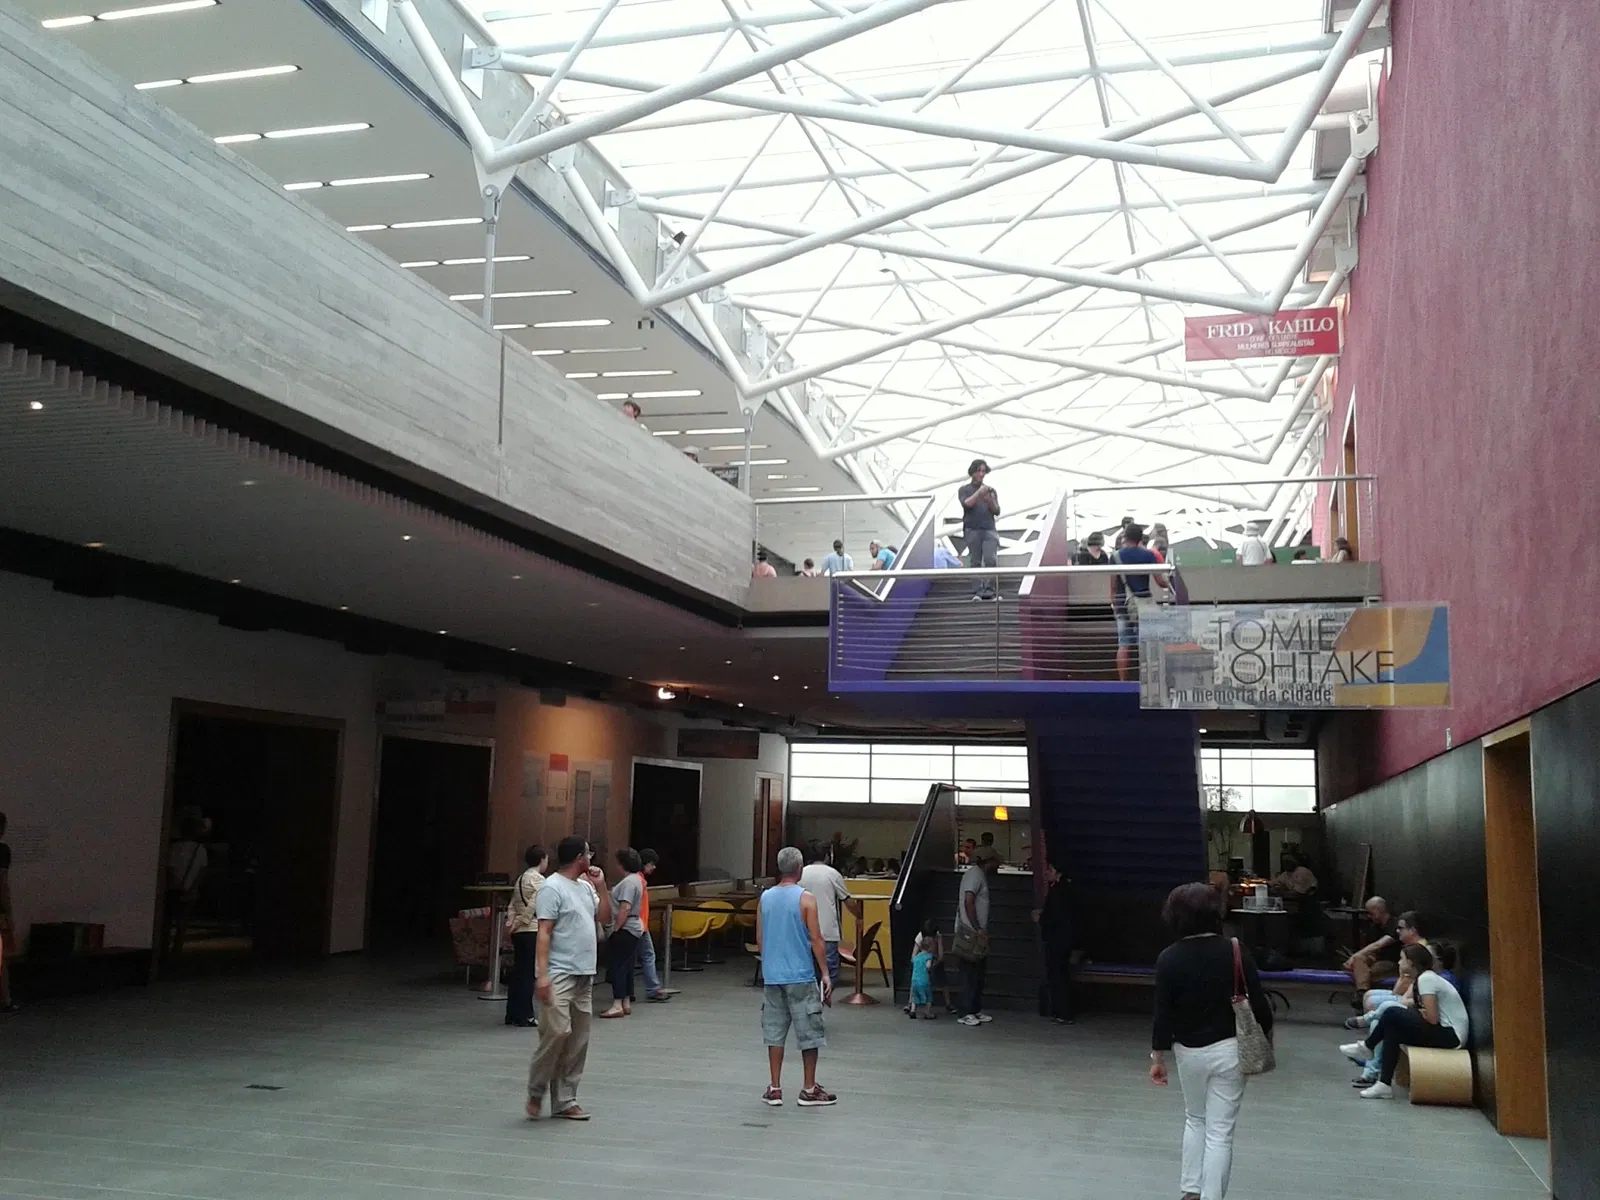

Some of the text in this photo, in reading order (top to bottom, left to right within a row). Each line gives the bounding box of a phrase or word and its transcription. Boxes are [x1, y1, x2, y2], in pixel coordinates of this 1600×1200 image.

[1206, 323, 1254, 339] FRID
[1268, 317, 1335, 335] KAHLO
[1209, 617, 1337, 651] TOMIE
[1230, 650, 1395, 684] OHTAKE
[1259, 685, 1276, 701] da
[1281, 684, 1331, 701] cidade
